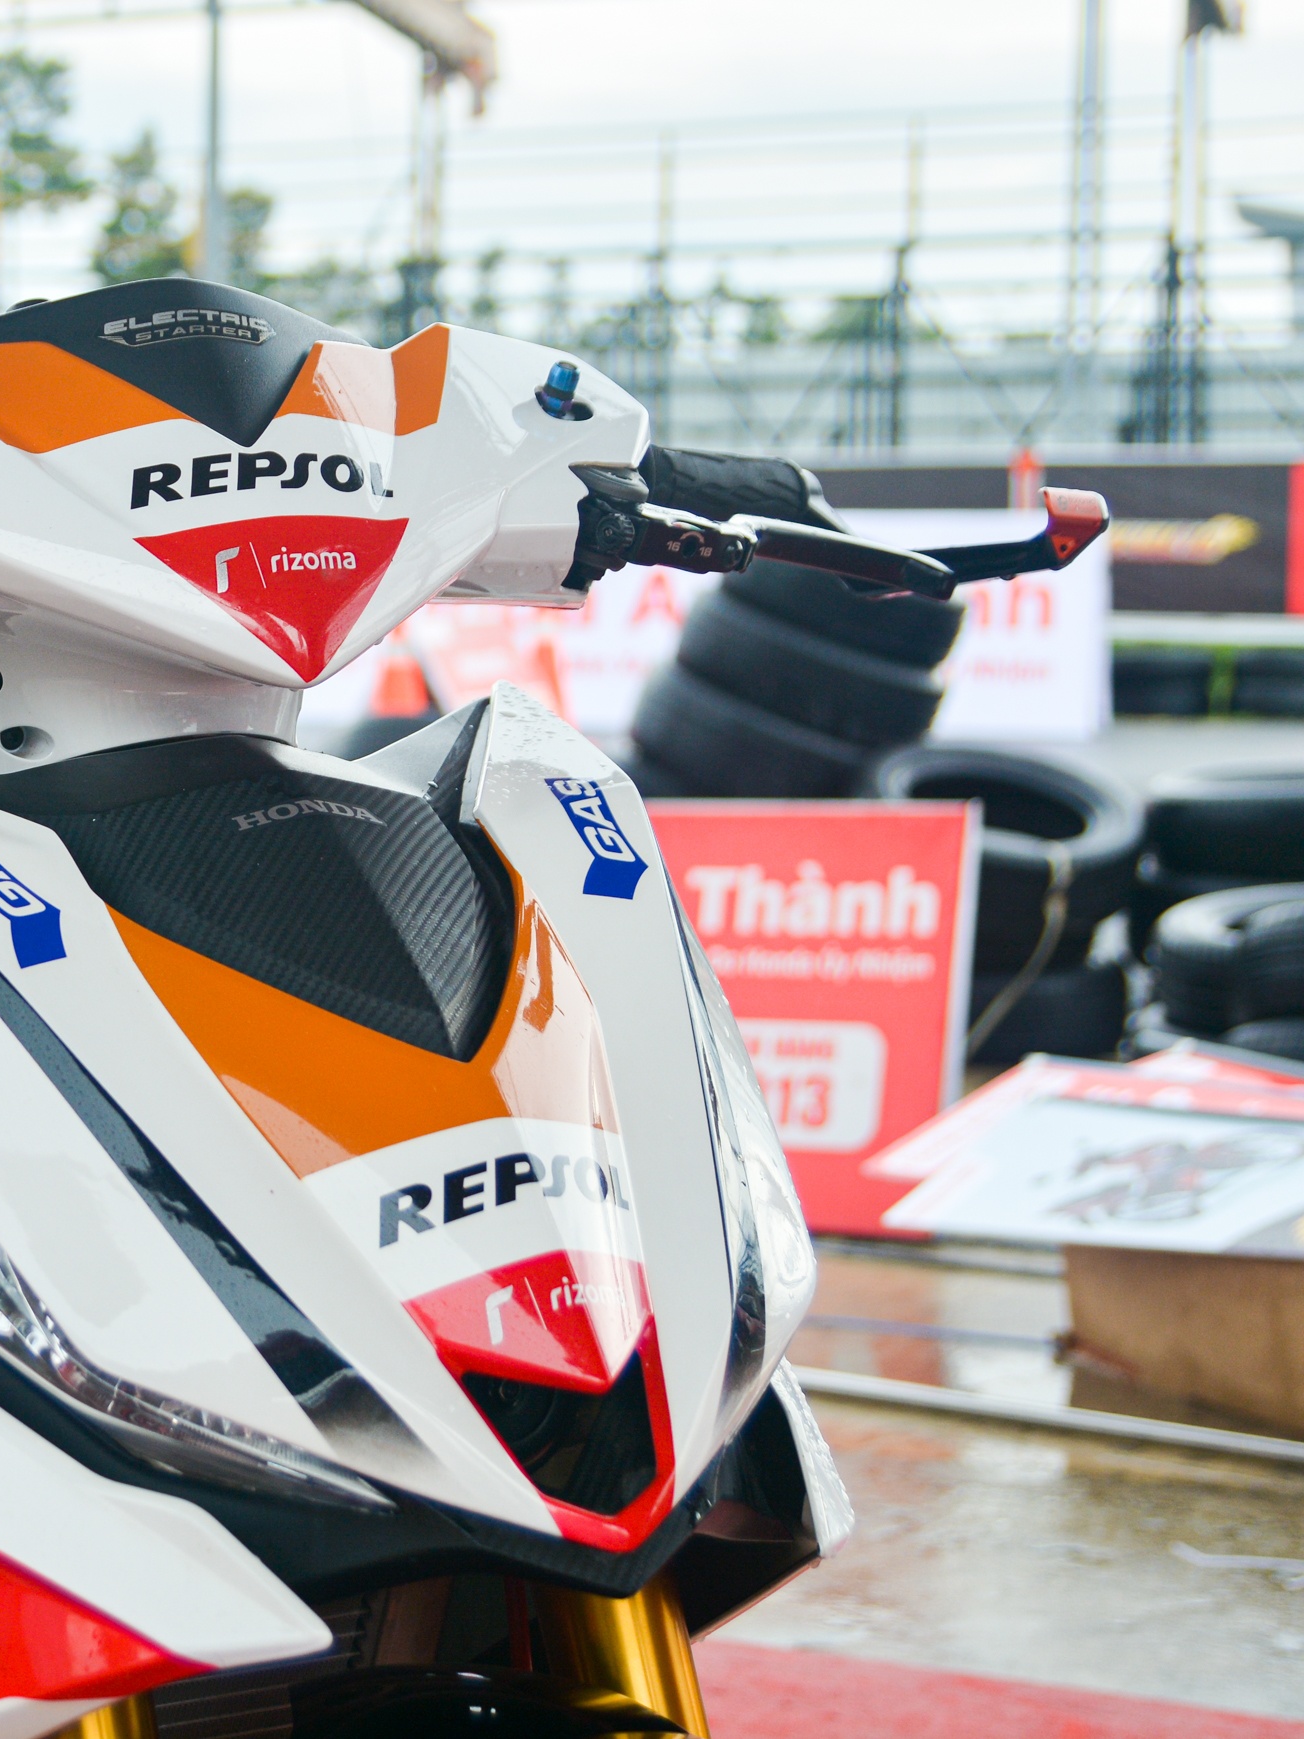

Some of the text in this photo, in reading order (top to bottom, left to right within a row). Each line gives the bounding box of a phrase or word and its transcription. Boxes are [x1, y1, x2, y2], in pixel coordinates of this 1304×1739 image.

[103, 308, 269, 335] ELECTRIC
[134, 324, 252, 340] STARTER
[130, 451, 394, 510] REPSOL
[270, 545, 357, 573] rizoma
[666, 540, 713, 558] 16 18
[232, 799, 388, 831] HONDA
[553, 779, 636, 862] GAS
[686, 860, 940, 938] Thành
[379, 1152, 630, 1248] REPSOL
